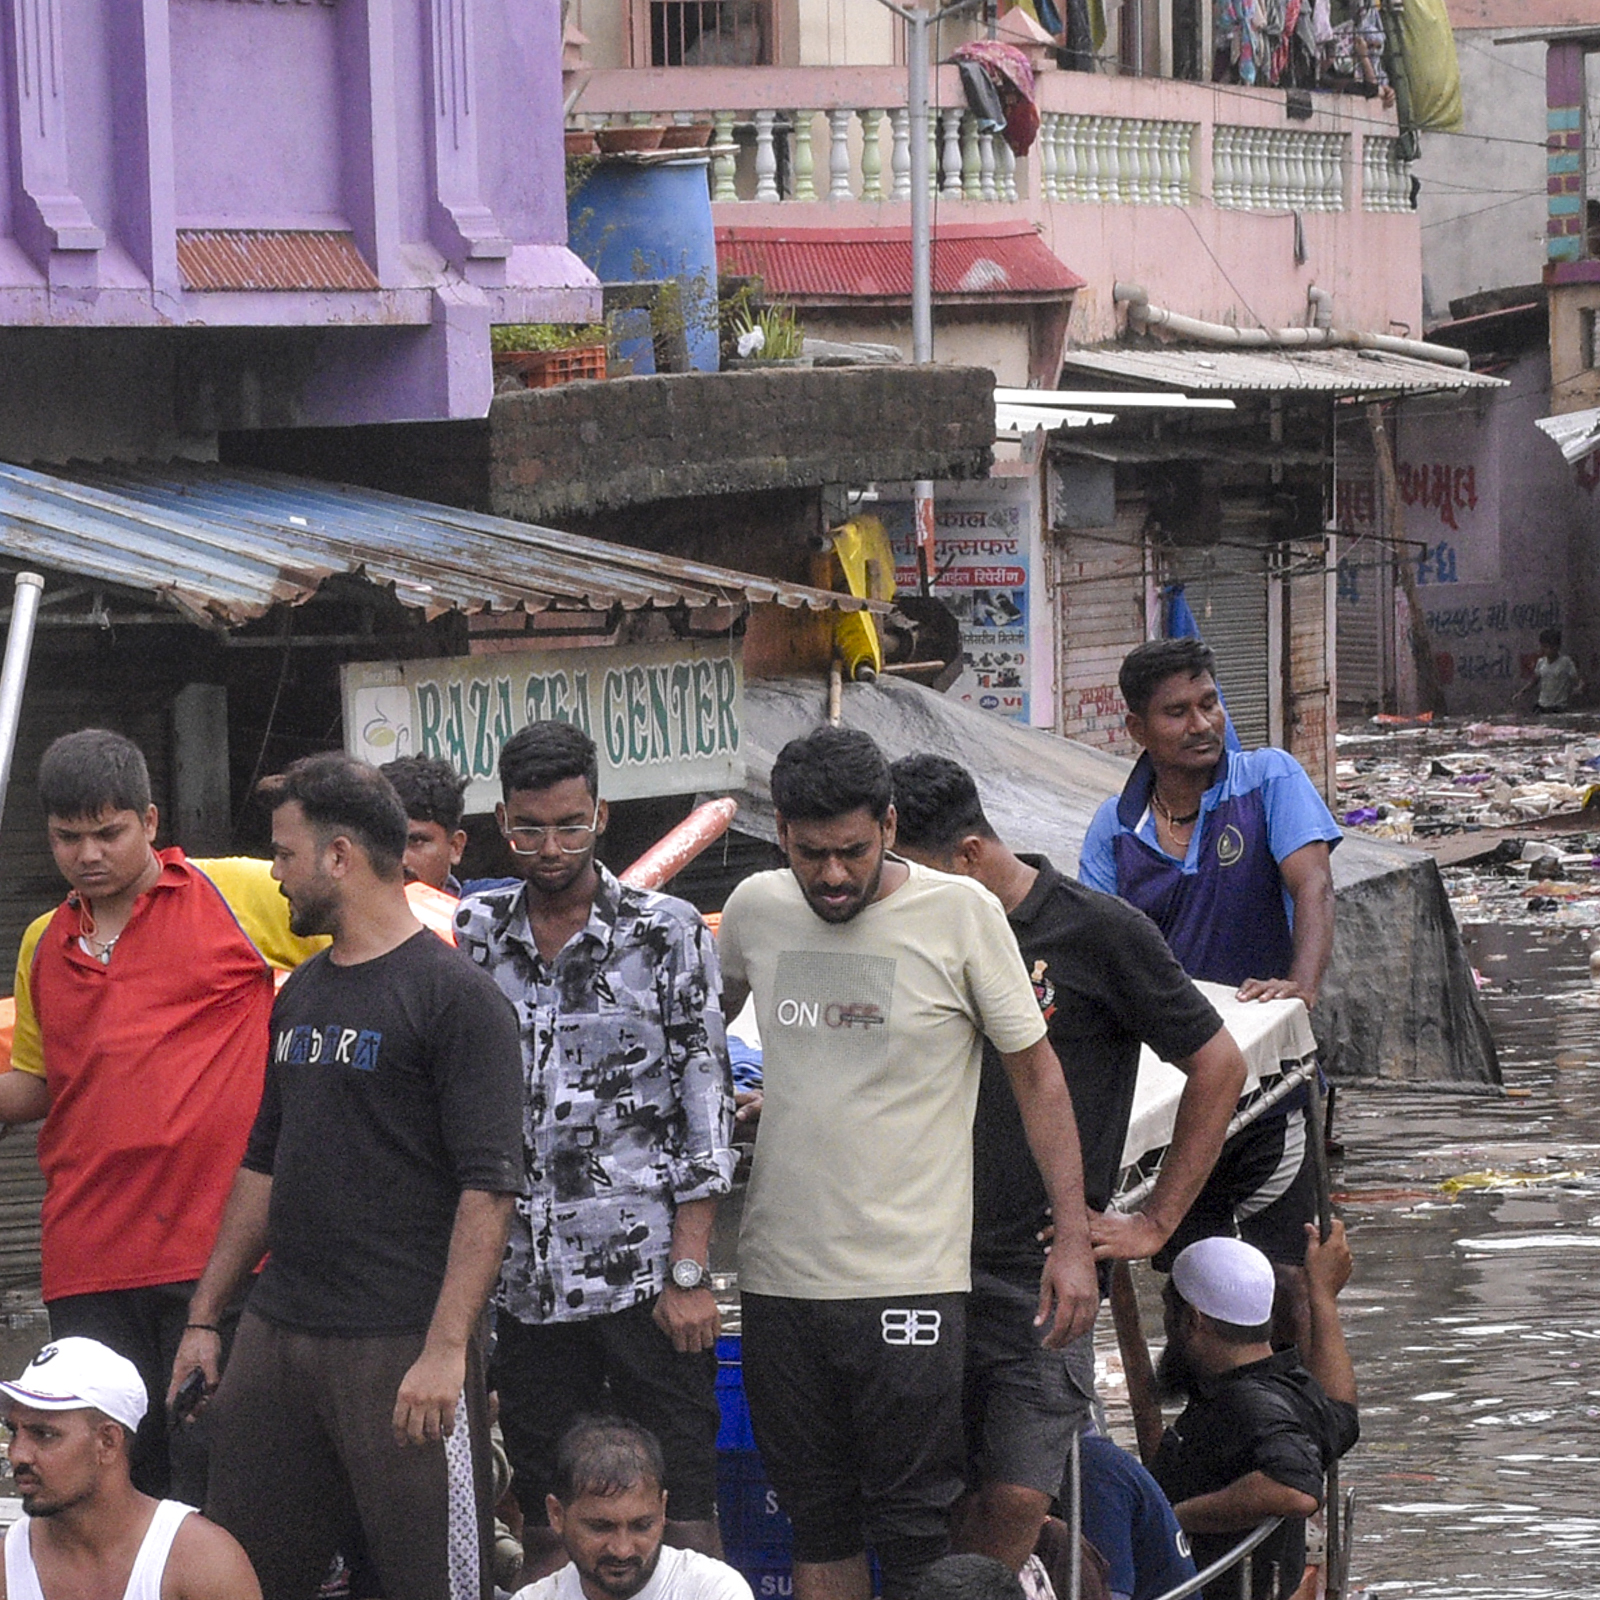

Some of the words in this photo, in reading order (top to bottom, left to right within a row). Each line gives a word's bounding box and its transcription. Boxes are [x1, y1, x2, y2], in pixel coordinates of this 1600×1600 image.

[415, 674, 514, 782] RAZA
[603, 656, 741, 769] CENTER
[777, 999, 820, 1027] ON
